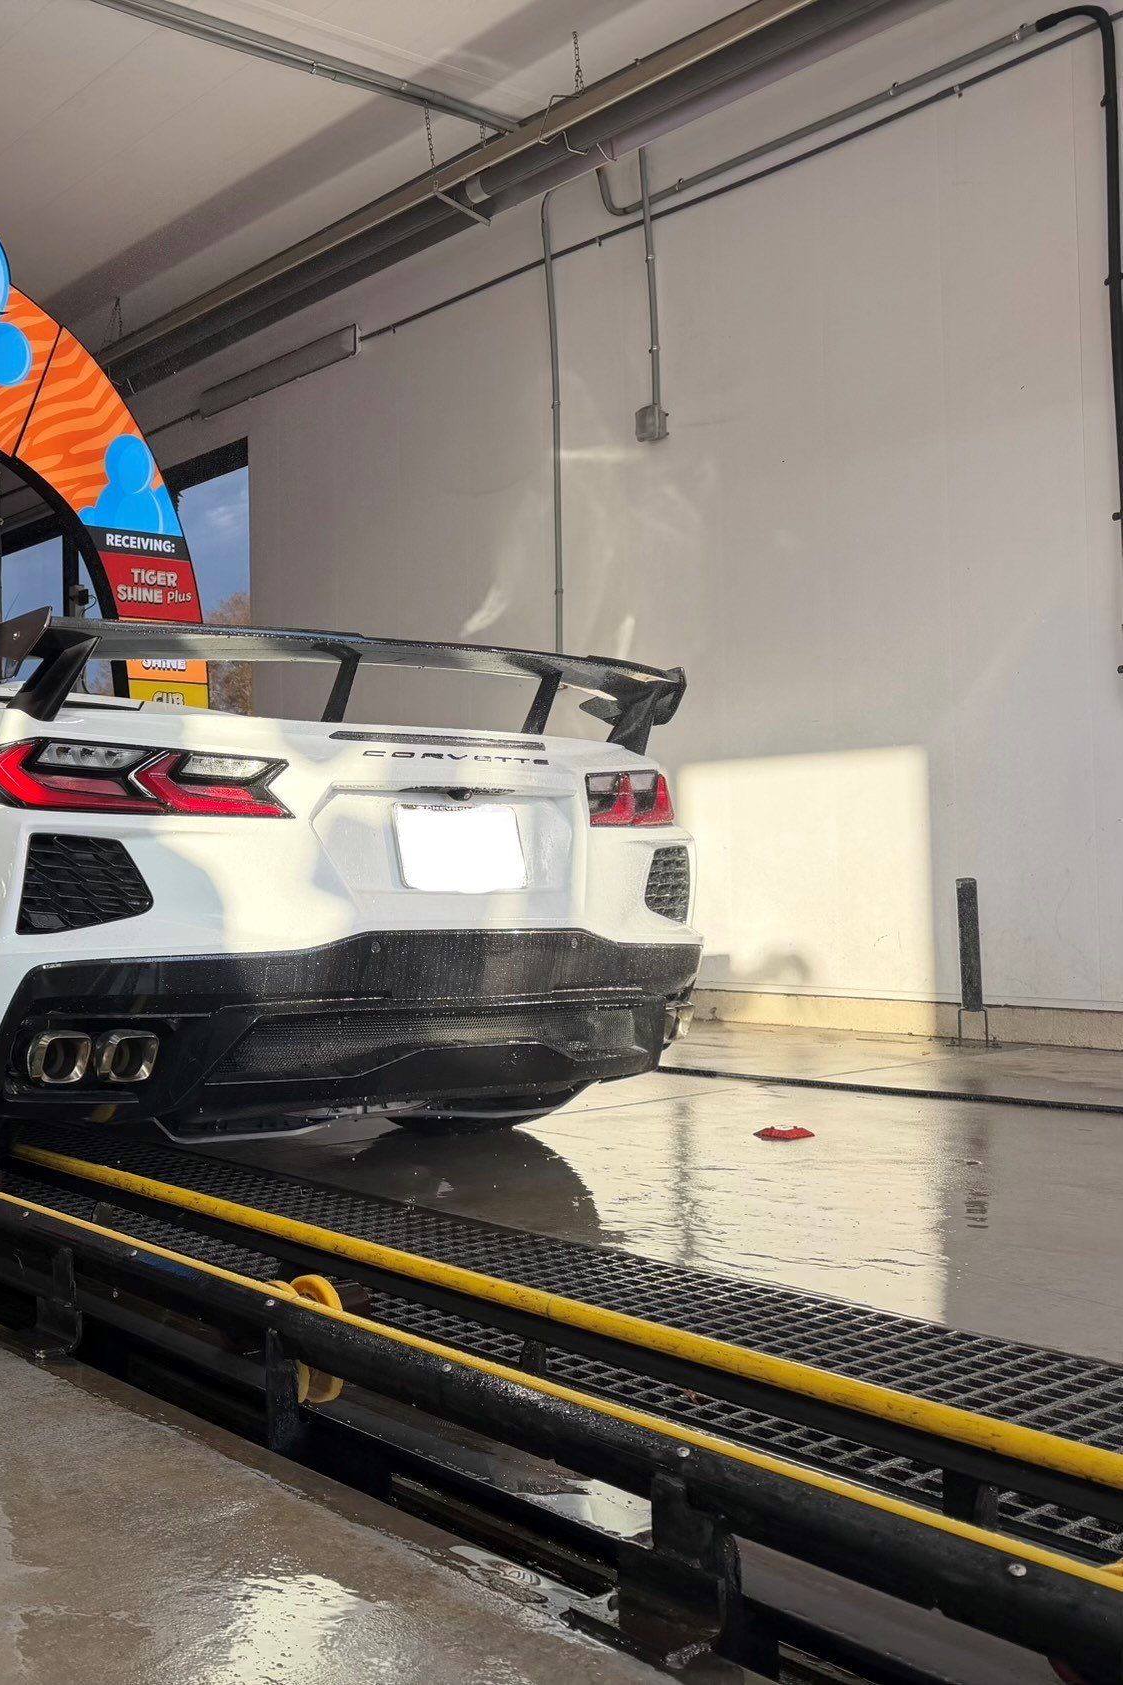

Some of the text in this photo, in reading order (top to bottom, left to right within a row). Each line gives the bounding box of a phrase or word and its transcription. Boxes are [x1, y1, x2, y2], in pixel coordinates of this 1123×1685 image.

[105, 533, 176, 553] RECEIVING:
[130, 567, 178, 588] TIGER
[116, 583, 163, 604] SHINE
[362, 750, 550, 765] CORVETTE
